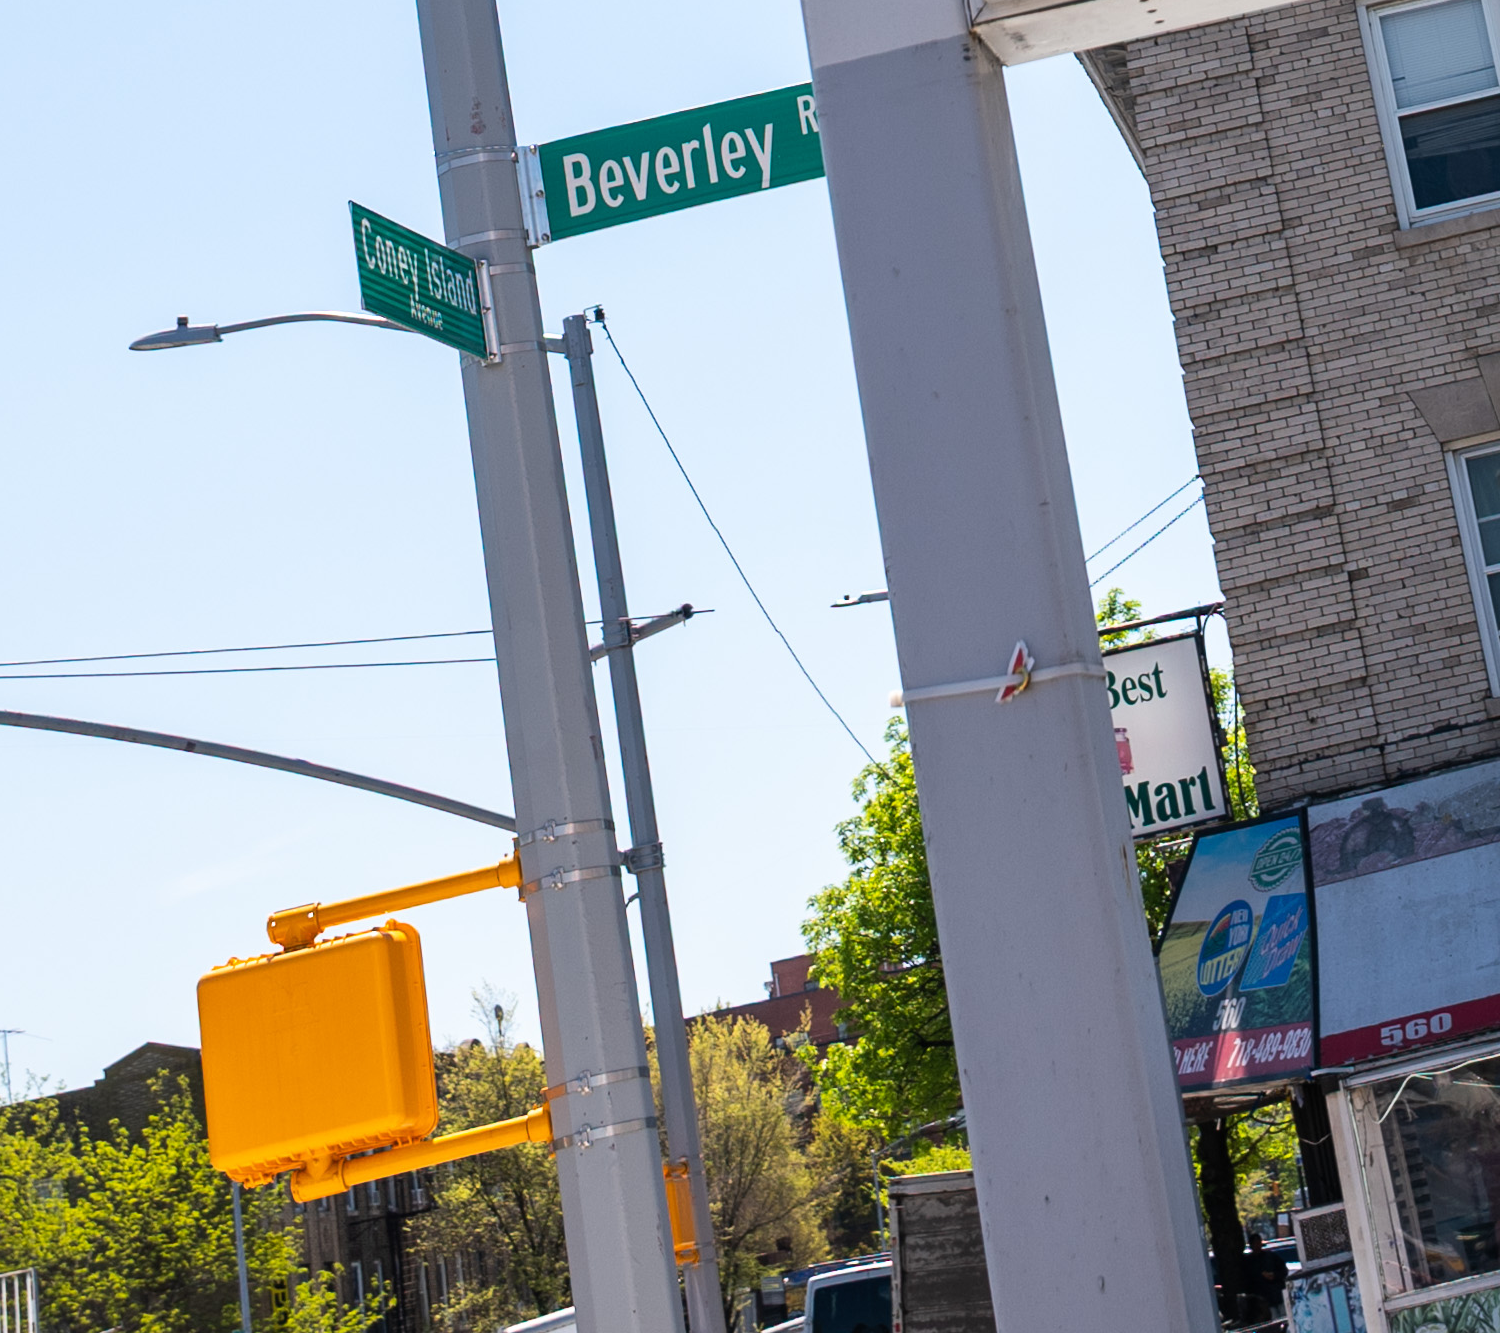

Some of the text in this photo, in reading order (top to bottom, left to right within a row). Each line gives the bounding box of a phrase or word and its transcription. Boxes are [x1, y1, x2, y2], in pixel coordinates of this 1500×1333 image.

[562, 94, 820, 218] Beverley R
[360, 217, 477, 316] Coney Island
[409, 293, 444, 331] Avenue
[1106, 661, 1168, 710] Best
[1124, 766, 1216, 829] Mart
[1255, 853, 1279, 870] OPEN
[1230, 908, 1249, 925] NEW
[1228, 923, 1250, 949] YORK
[1212, 996, 1248, 1032] 560
[1380, 1012, 1453, 1047] 560
[1178, 1039, 1214, 1075] HERE
